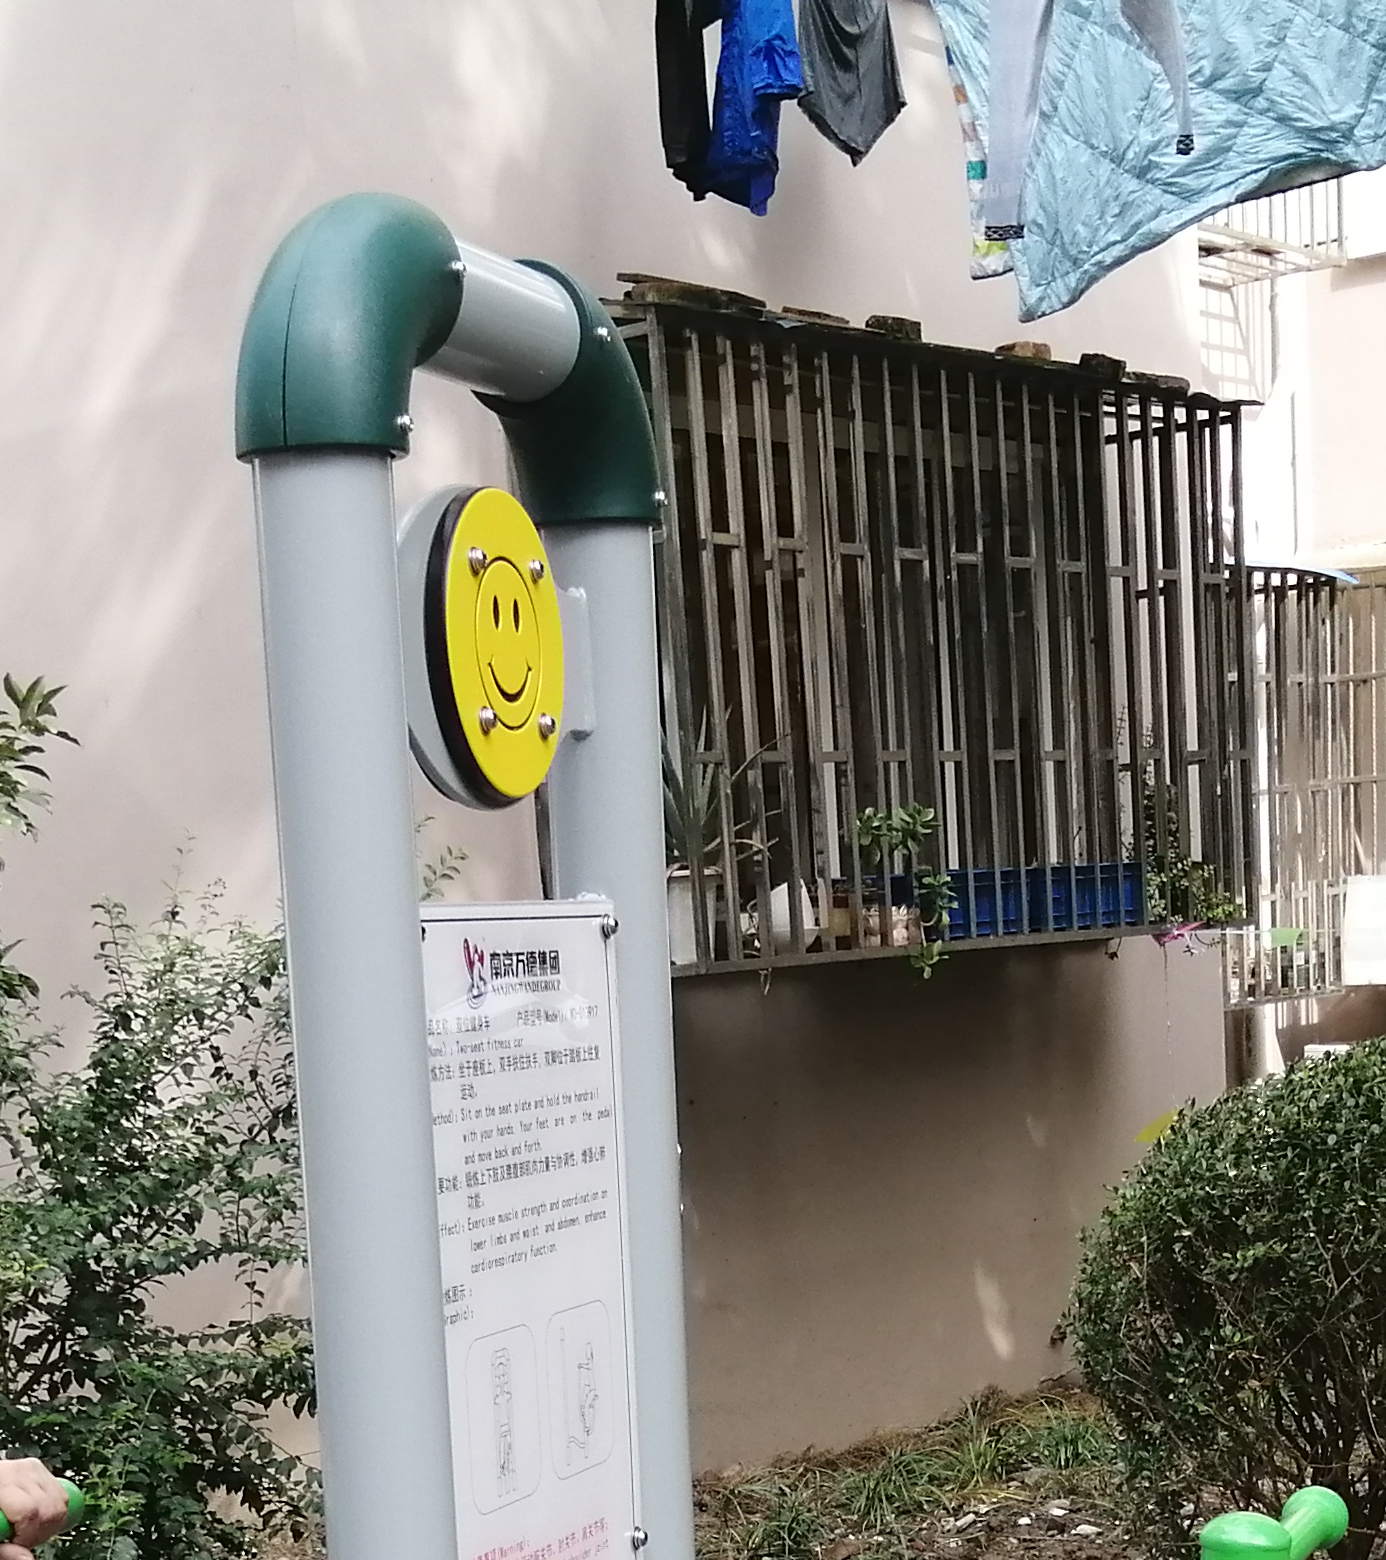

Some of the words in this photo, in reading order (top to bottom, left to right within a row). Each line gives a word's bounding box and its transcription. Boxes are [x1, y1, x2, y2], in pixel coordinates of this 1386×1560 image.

[490, 950, 560, 980] 南京万德集团
[487, 1038, 511, 1051] fitness
[513, 1037, 524, 1048] car
[461, 1107, 472, 1122] Sit
[475, 1109, 483, 1118] on
[485, 1105, 496, 1117] the
[498, 1103, 513, 1116] seat
[514, 1100, 532, 1114] plate
[534, 1098, 545, 1110] and
[546, 1095, 559, 1109] hold
[562, 1093, 572, 1105] the
[574, 1087, 600, 1103] handrail
[463, 1129, 478, 1143] with
[480, 1128, 493, 1143] your
[519, 1120, 533, 1133] Your
[536, 1117, 550, 1130] feet
[554, 1116, 565, 1127] are
[570, 1115, 578, 1124] on
[582, 1110, 593, 1121] the
[597, 1105, 613, 1121] pedal
[464, 1151, 476, 1165] and
[478, 1150, 492, 1162] move
[494, 1146, 509, 1160] back
[511, 1143, 522, 1156] and
[467, 1216, 495, 1231] Exercise
[498, 1208, 518, 1224] muscle
[521, 1201, 548, 1219] strength
[549, 1197, 560, 1211] and
[561, 1190, 599, 1209] coordination
[470, 1238, 487, 1252] lower
[490, 1233, 507, 1248] limbs
[510, 1229, 520, 1243] and
[522, 1225, 539, 1239] waist
[545, 1221, 555, 1234] and
[585, 1209, 606, 1224] enhance
[471, 1248, 527, 1274] cardiorespiratory
